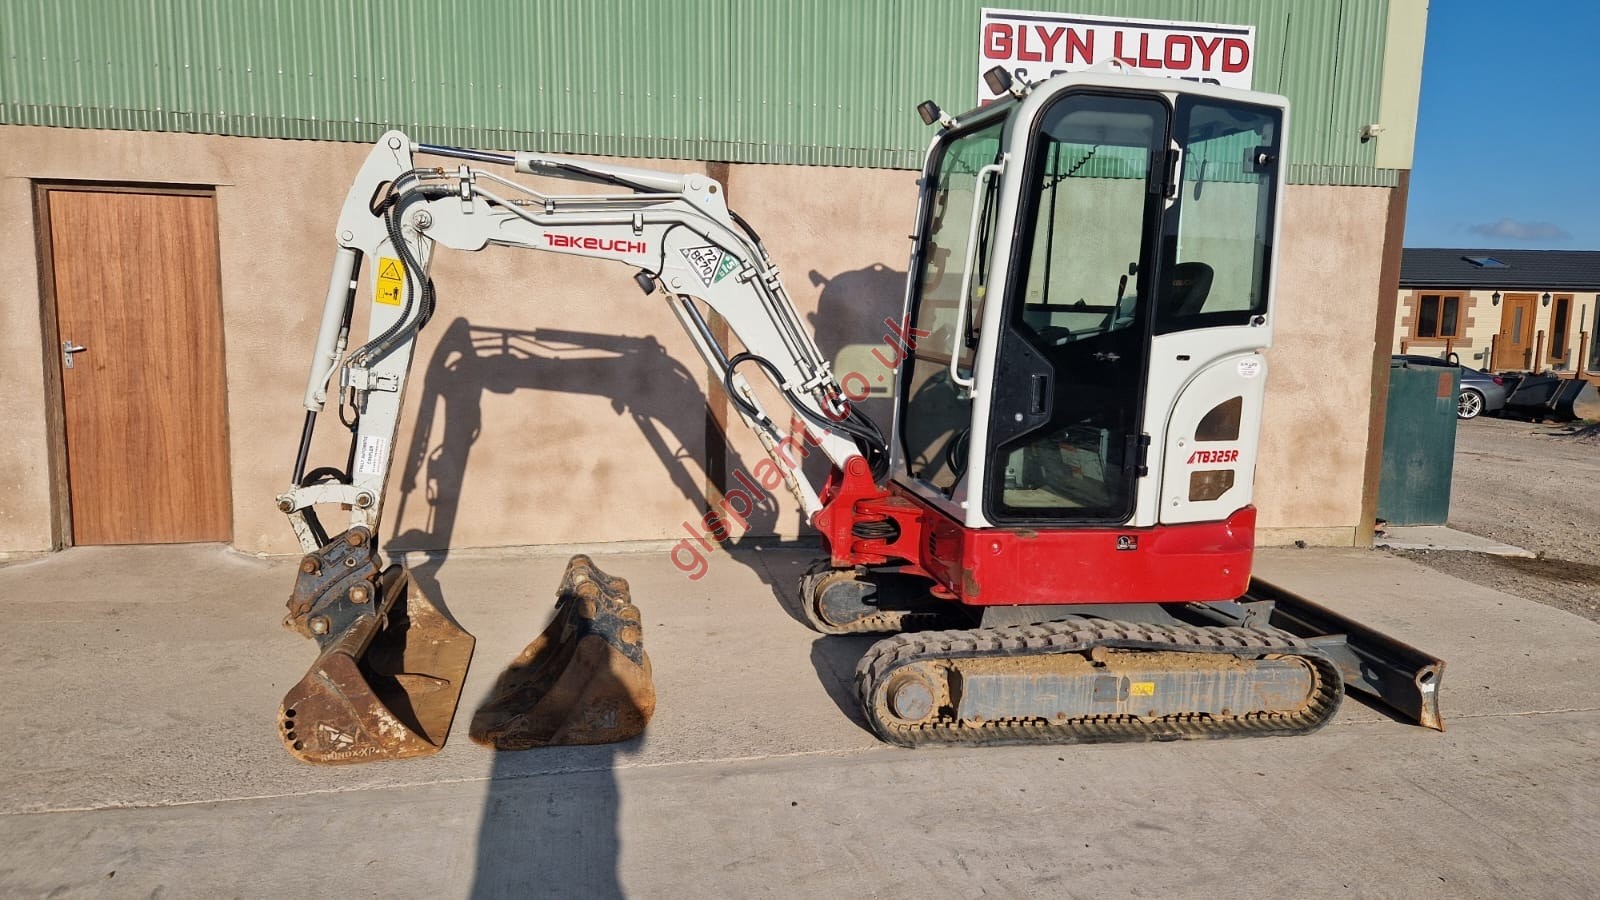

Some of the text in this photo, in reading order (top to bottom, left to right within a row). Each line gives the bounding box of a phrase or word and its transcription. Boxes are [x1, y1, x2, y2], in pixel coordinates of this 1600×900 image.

[984, 23, 1250, 74] GLYN LLOYD
[1196, 450, 1239, 463] TB325R
